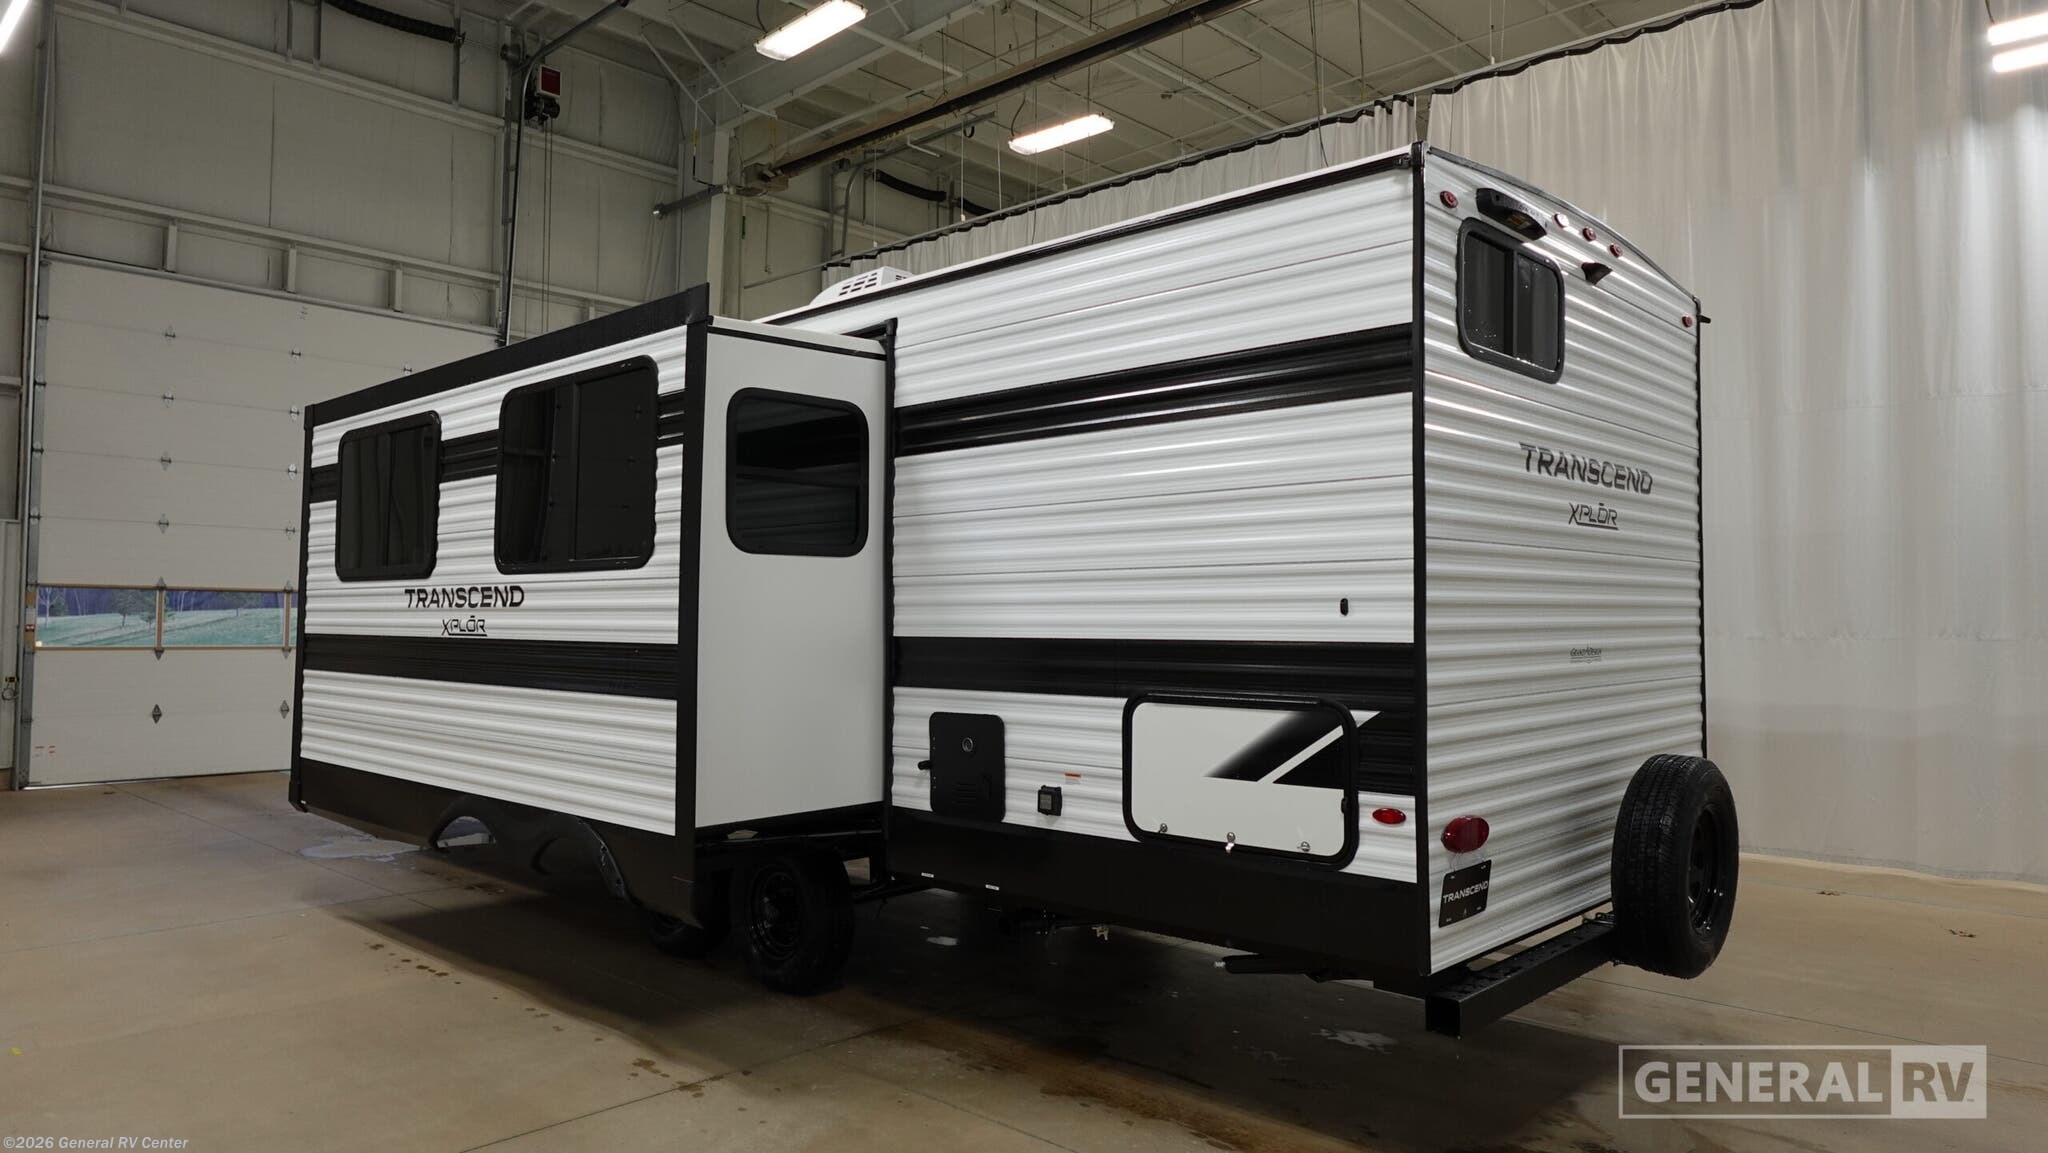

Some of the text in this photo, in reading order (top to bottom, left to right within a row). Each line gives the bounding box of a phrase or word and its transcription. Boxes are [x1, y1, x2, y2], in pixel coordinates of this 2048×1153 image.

[1519, 441, 1653, 495] TRANSCEND
[404, 585, 525, 609] TRANSCEND
[1442, 880, 1489, 904] TRANSCEND
